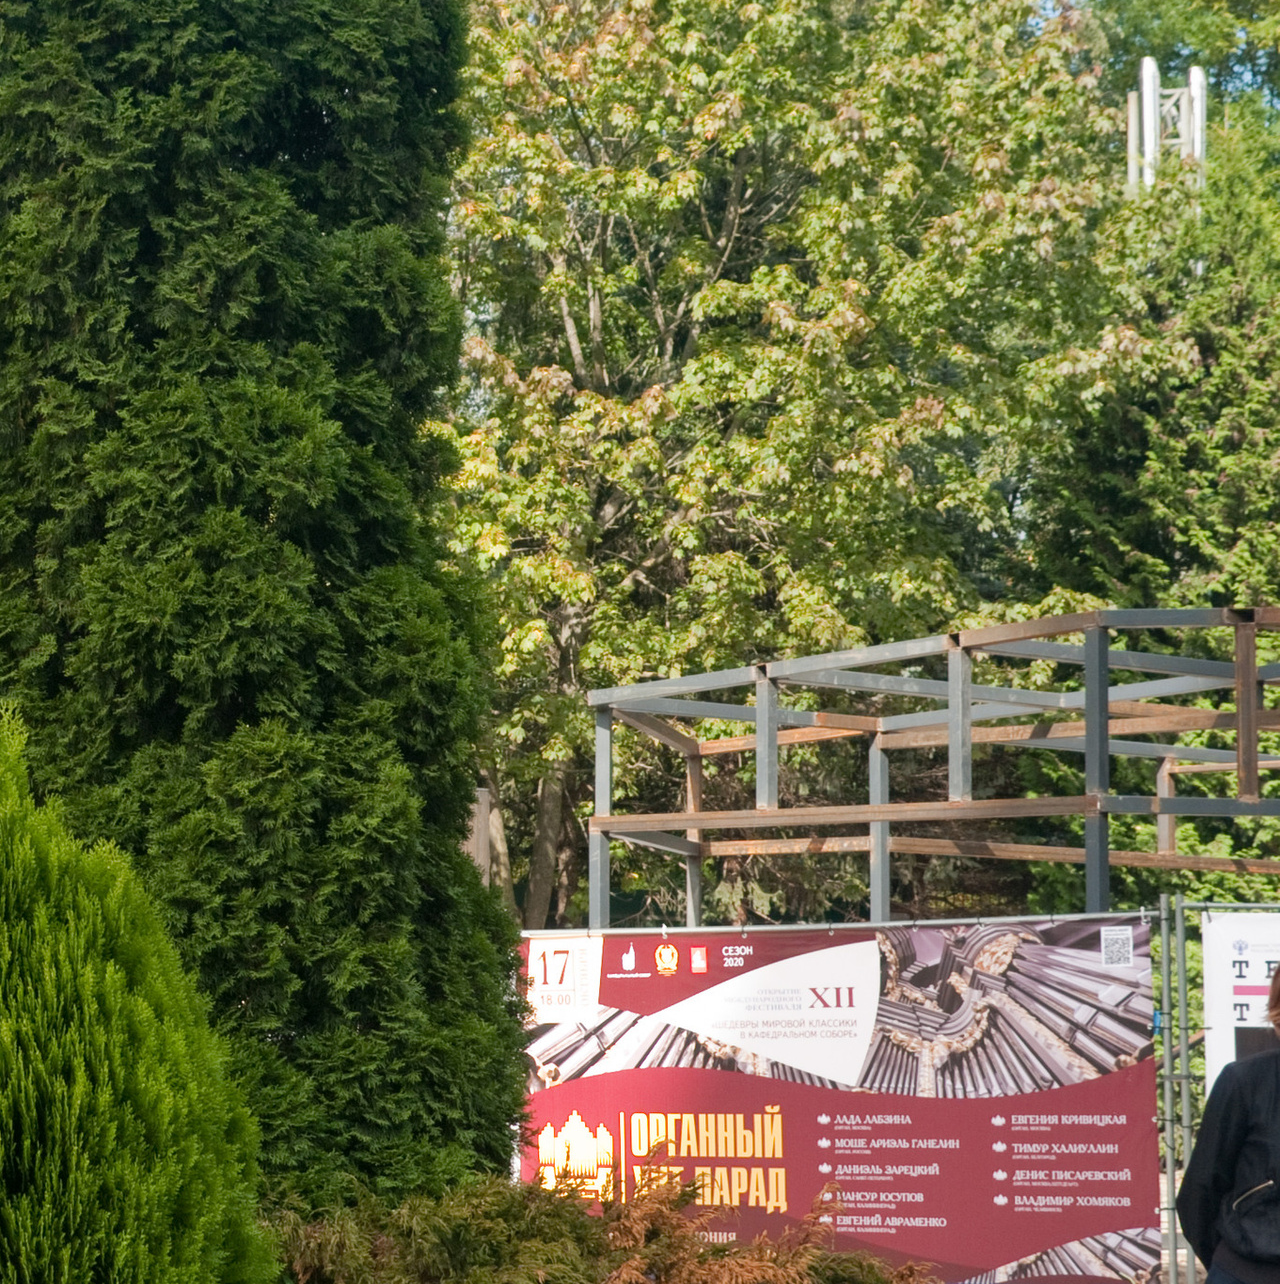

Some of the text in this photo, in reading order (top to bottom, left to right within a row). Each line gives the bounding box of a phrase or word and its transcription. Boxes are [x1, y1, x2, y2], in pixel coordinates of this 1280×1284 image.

[722, 945, 753, 956] СЕЗОН
[538, 950, 569, 985] 17
[723, 957, 744, 967] 2020
[809, 986, 856, 1009] XII
[762, 1018, 805, 1029] МИРОВОЙ
[809, 1019, 857, 1028] КЛАССИКИ
[748, 1030, 817, 1040] КАФЕДРАЛЬНОМ
[834, 1115, 912, 1125] ЛАДА ЛАБЗИНА
[1011, 1115, 1126, 1126] ЕВГЕНИЯ КРИВИЦКАЯ
[631, 1104, 783, 1158] ОРГАННЫЙ
[835, 1139, 960, 1149] МОШЕ АРИЭЛЬ ГАНЕЛИН
[1011, 1144, 1118, 1153] ТИМУР ХАЛИУЛЛИН
[835, 1163, 939, 1176] ДАНИЭЛЬ ЗАРЕЦКИЙ
[1013, 1169, 1131, 1181] ДЕНИС ПИСАРЕВСКИЙ
[836, 1192, 924, 1202] МАНСУР ЮСУПОВ
[1014, 1196, 1131, 1206] ВЛАДИМИР ХОМЯКОВ
[836, 1214, 947, 1227] ЕВГЕНИЙ АВРАМЕНКО
